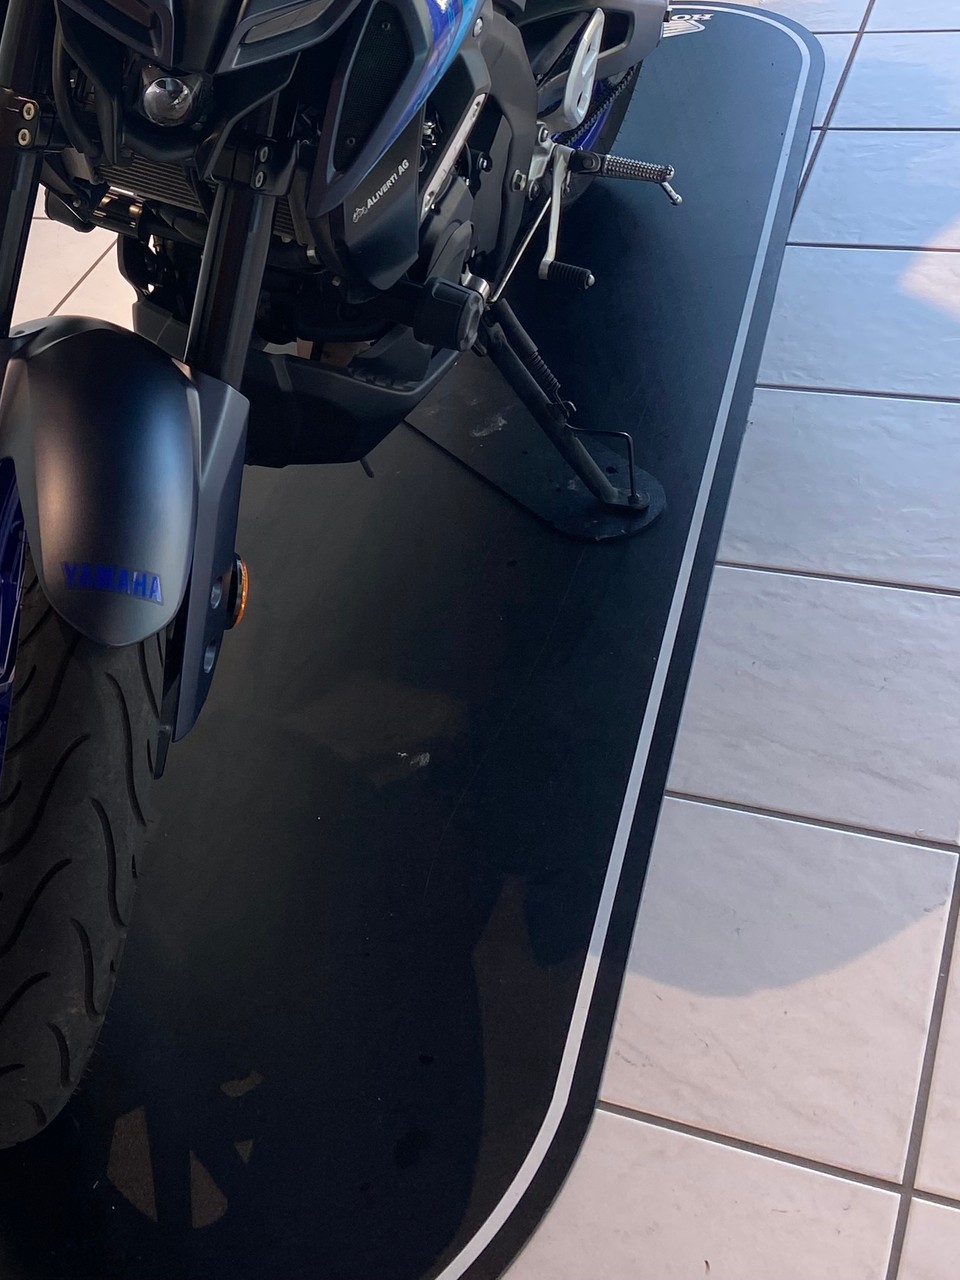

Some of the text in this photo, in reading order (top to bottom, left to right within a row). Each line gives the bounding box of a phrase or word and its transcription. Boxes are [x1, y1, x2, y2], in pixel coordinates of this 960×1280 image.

[367, 160, 409, 208] ALIVERTI AG
[63, 561, 162, 603] YAMAHA
